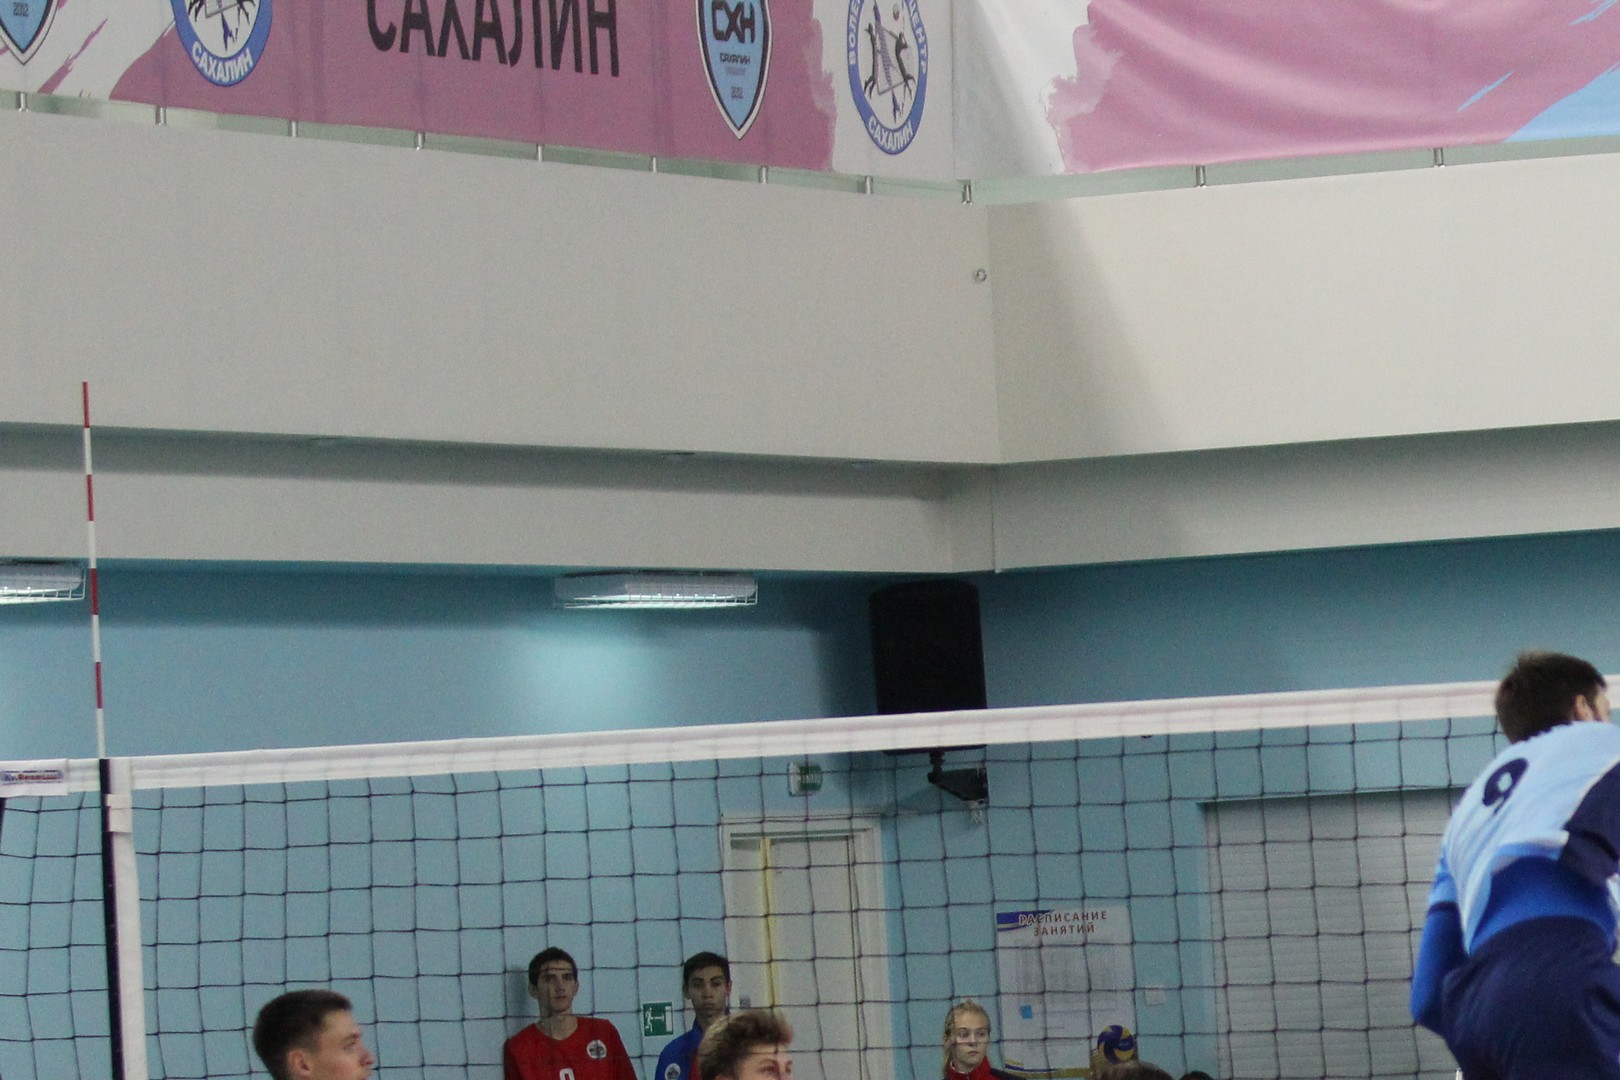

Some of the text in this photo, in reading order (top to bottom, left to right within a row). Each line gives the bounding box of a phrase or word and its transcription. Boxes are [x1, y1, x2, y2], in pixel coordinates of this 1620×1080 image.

[191, 41, 254, 83] САХАЛИН
[868, 115, 914, 151] САХАЛИН
[1482, 758, 1529, 816] 9
[1019, 910, 1108, 925] РАСПИСАНИЕ
[1034, 923, 1096, 937] ЗАНЯТИЙ
